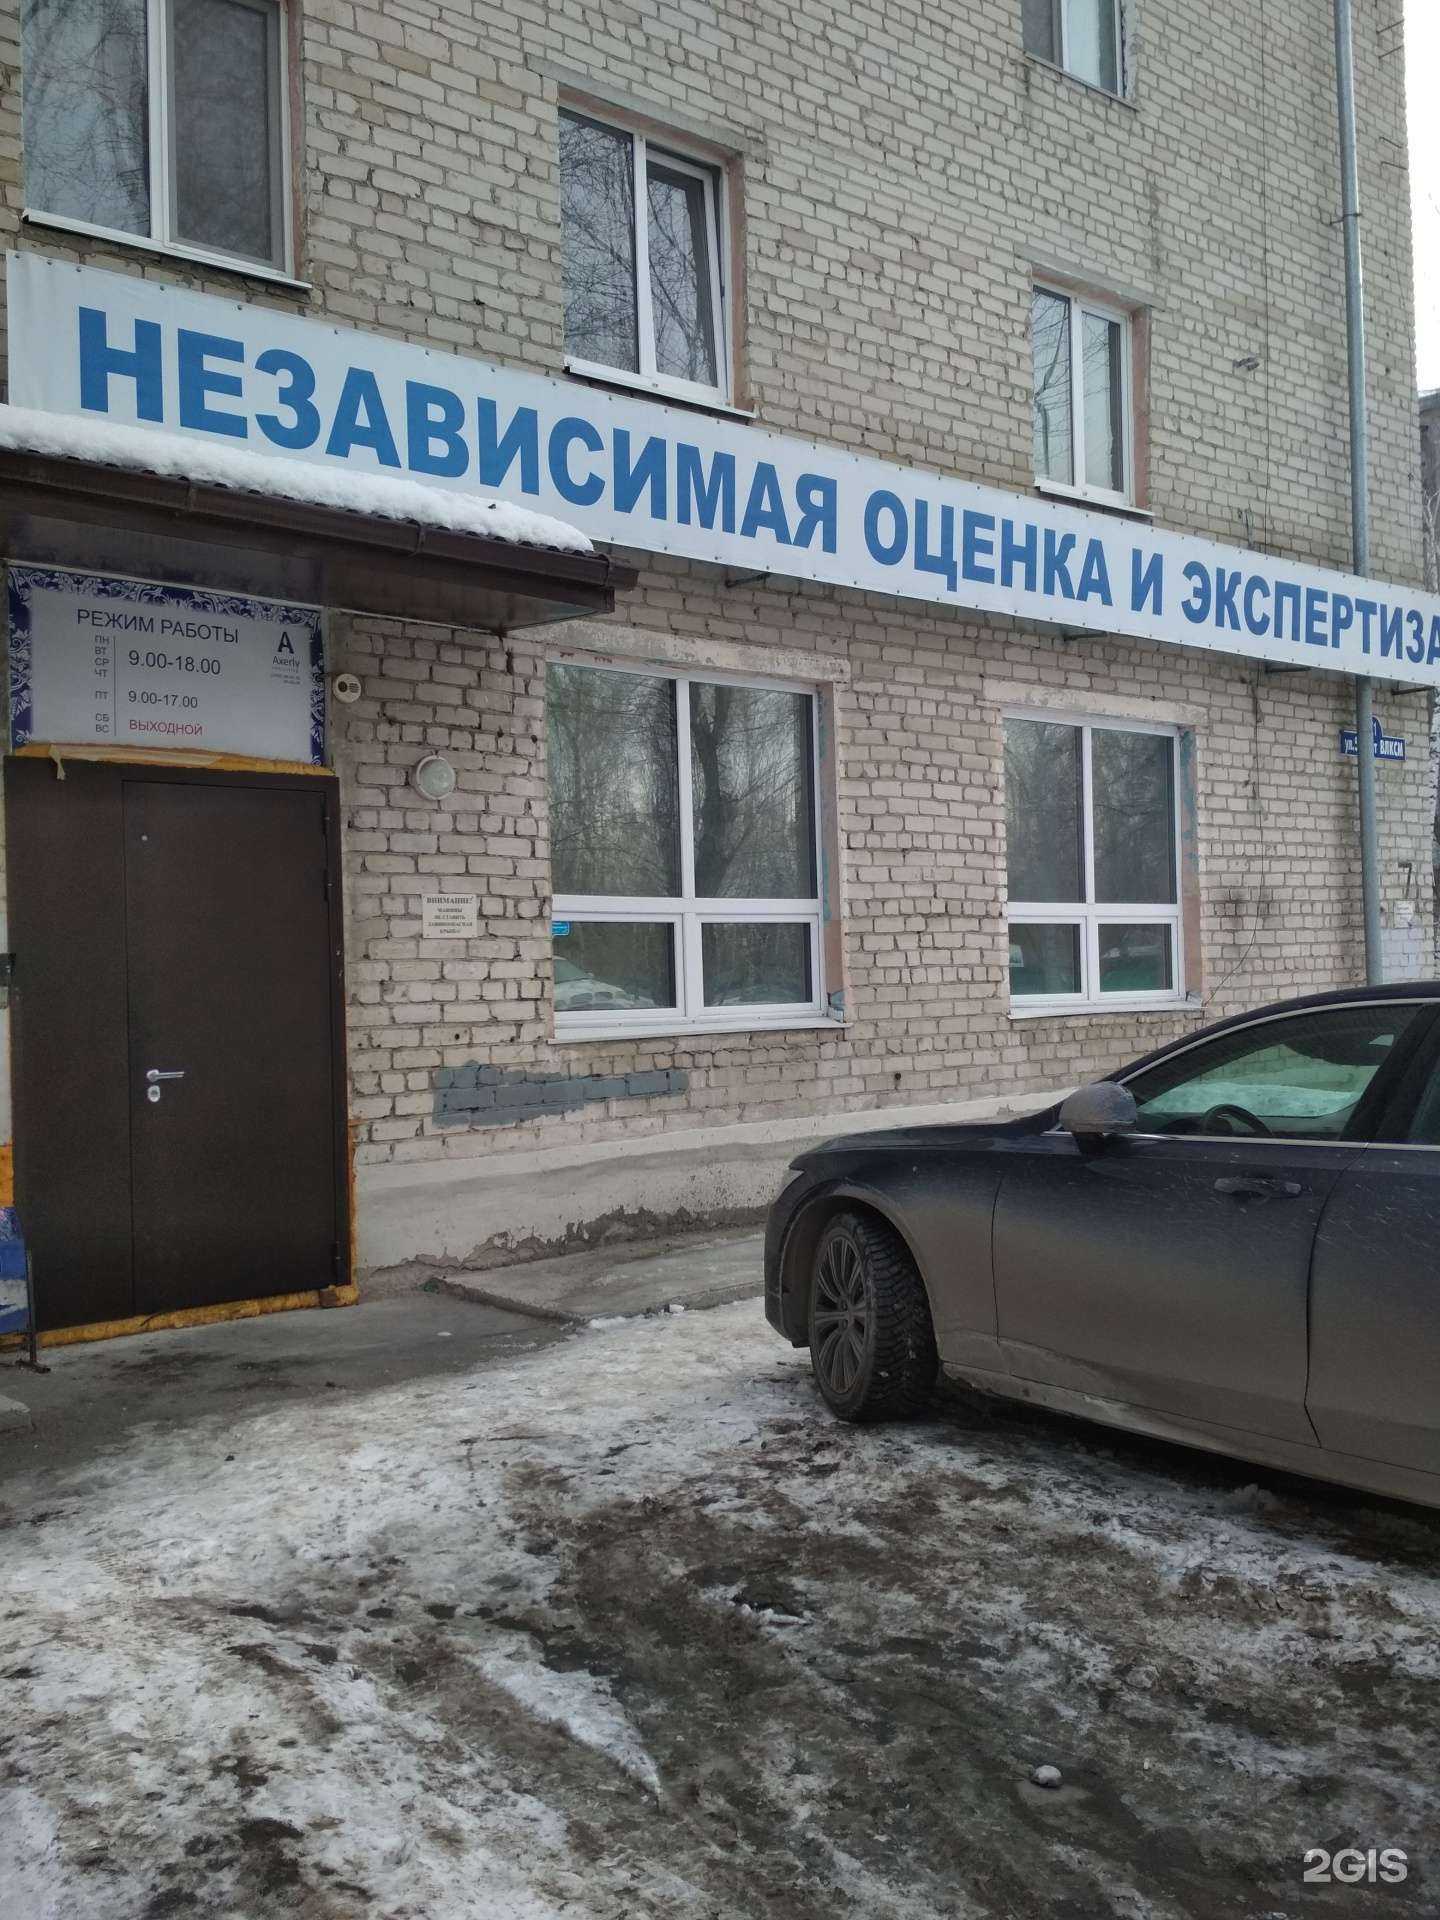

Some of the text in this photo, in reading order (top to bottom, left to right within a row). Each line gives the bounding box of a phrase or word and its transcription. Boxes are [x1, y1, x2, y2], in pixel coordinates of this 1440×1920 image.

[78, 306, 1440, 665] НЕЗАВИСИМАЯ ОЦЕНКА И ЭКСПЕРТИЗА
[77, 608, 239, 644] РЕЖИМ РАБОТЫ
[94, 657, 110, 666] СР
[128, 649, 221, 675] 9.00-18.00
[94, 668, 108, 678] ЧТ
[95, 690, 109, 700] ПТ
[128, 690, 198, 709] 9.00-17.00
[95, 713, 110, 722] СБ
[95, 724, 110, 734] ВС
[129, 719, 203, 735] ВЫХОДНОЙ
[1379, 739, 1404, 757] ВЛКСМ
